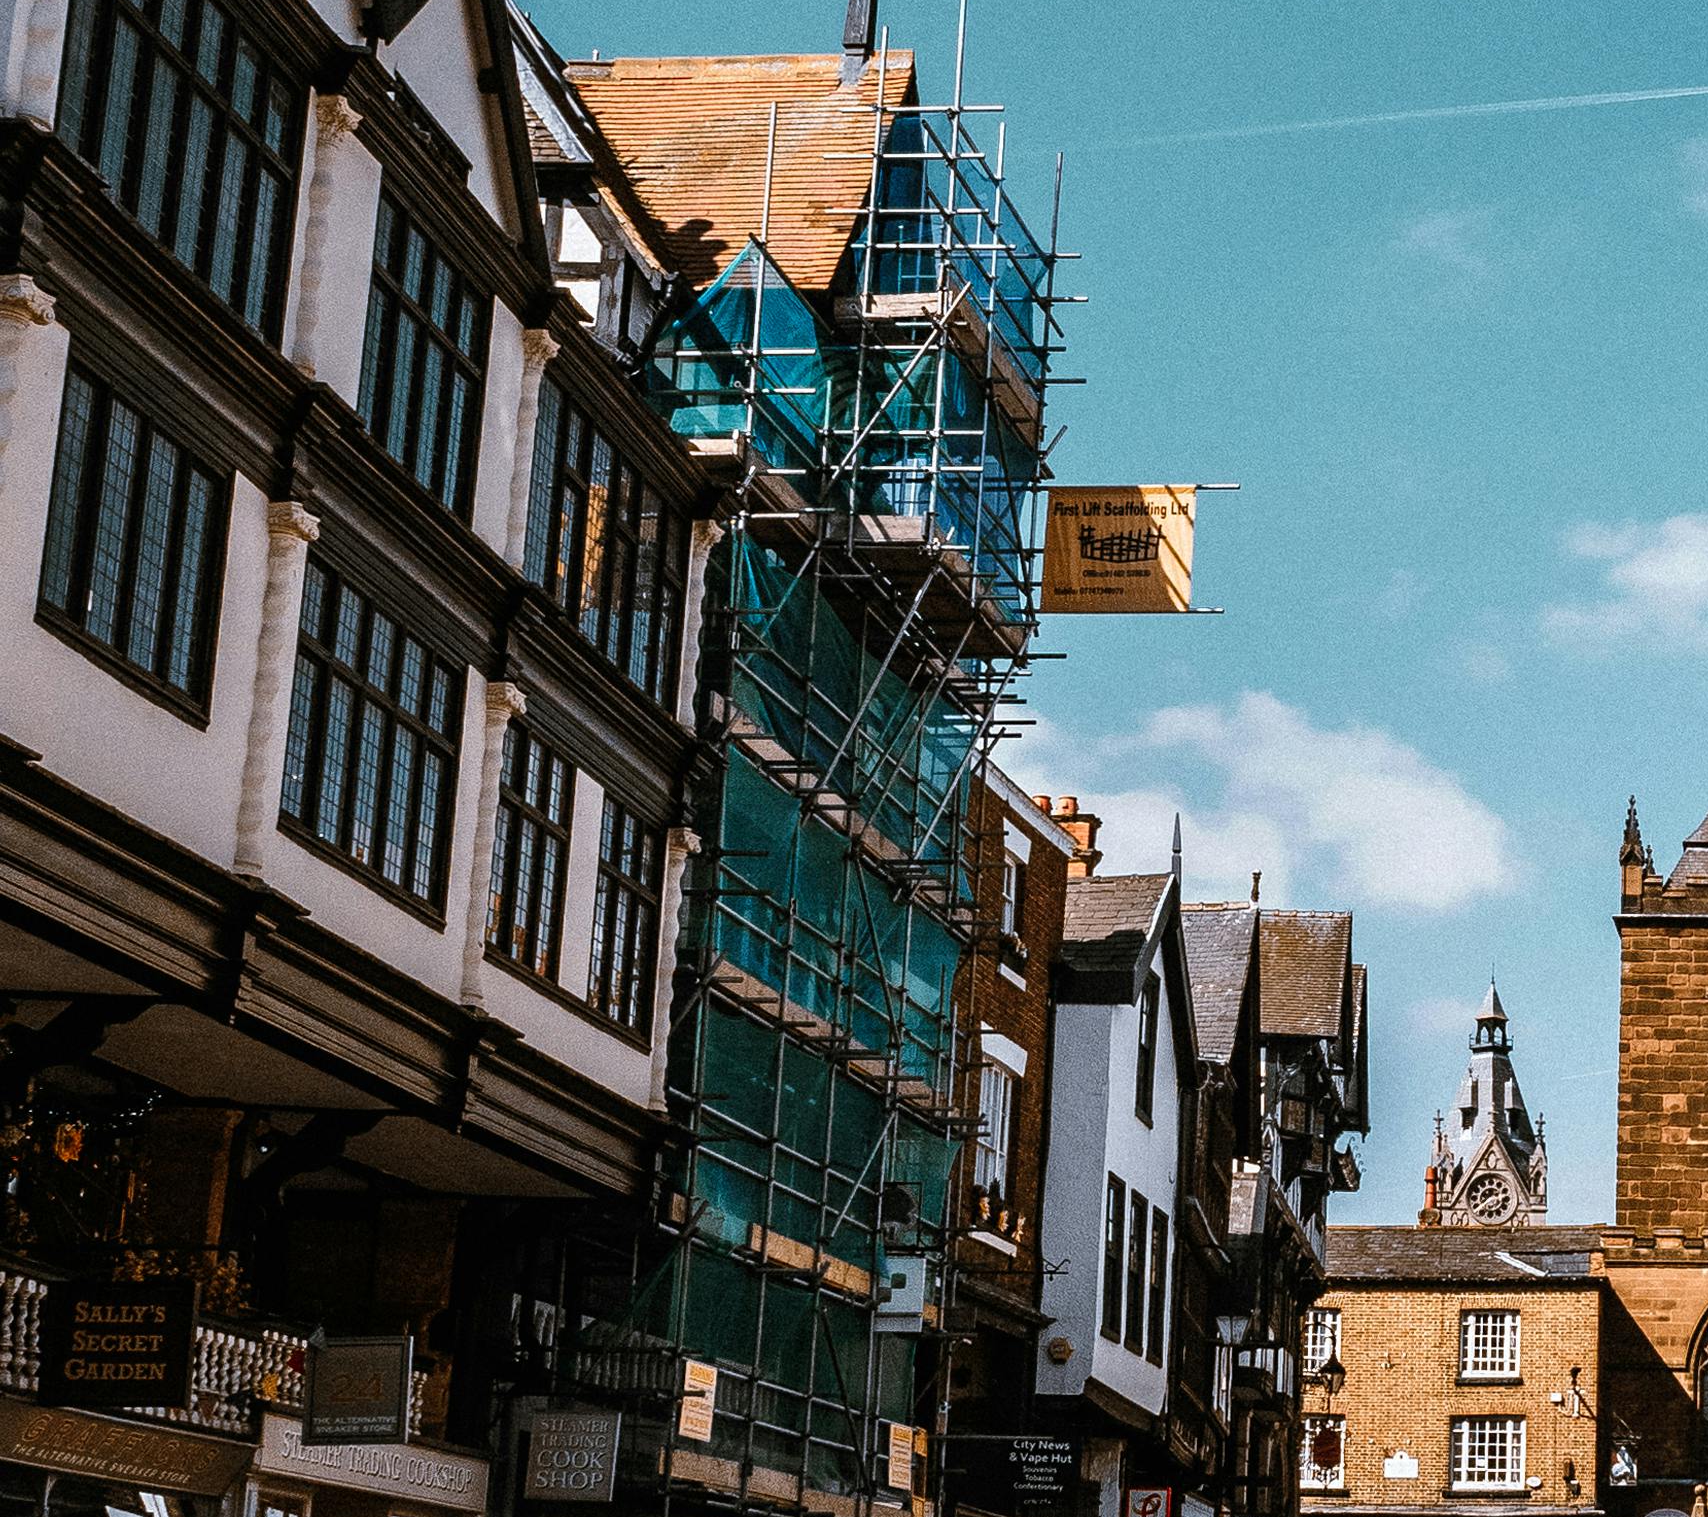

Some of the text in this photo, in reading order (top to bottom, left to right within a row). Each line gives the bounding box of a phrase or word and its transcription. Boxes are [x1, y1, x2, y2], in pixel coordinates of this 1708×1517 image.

[1054, 501, 1190, 519] First Lift Scaffolding Ltd
[74, 1301, 167, 1324] SALLY'S
[72, 1330, 164, 1353] SECRET
[64, 1358, 168, 1381] GARDEN
[541, 1434, 607, 1449] TRADING
[1013, 1440, 1071, 1451] City News
[13, 1444, 35, 1457] THE
[36, 1447, 108, 1470] ALTERNATIVE
[158, 1469, 192, 1485] STORE
[537, 1450, 605, 1469] COOK
[1009, 1452, 1072, 1465] & Vape Hut
[406, 1457, 474, 1494] COOKSHOP
[535, 1470, 605, 1490] SHOP
